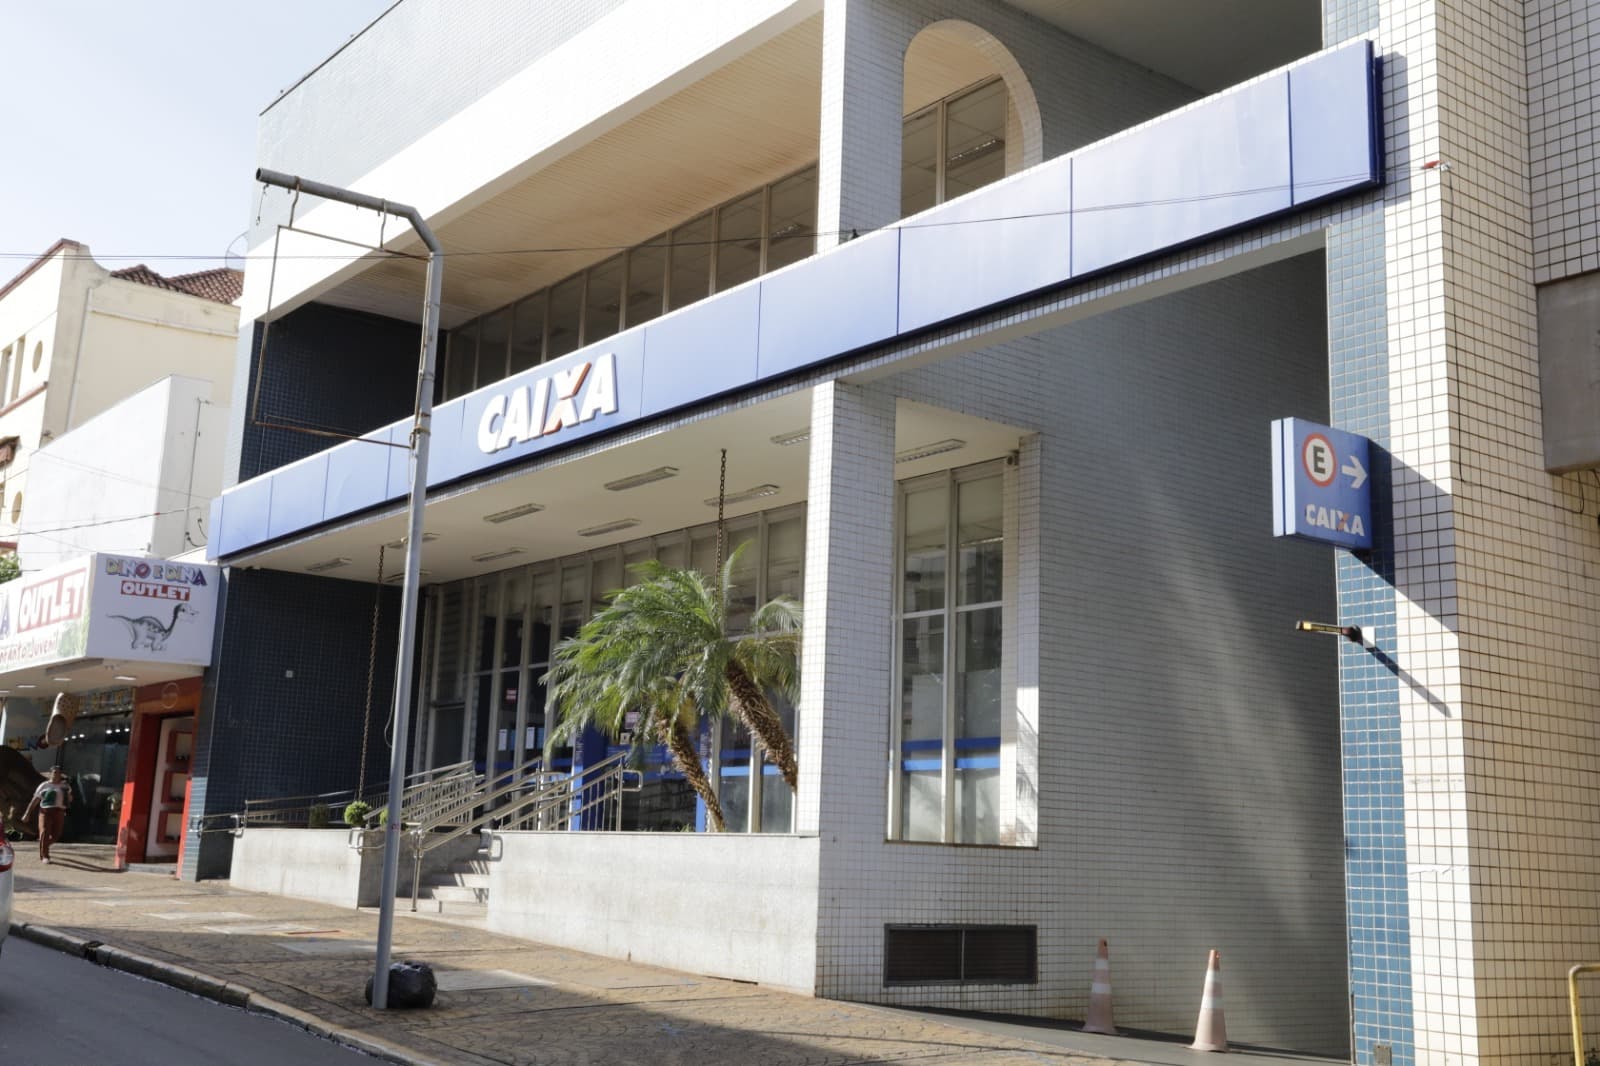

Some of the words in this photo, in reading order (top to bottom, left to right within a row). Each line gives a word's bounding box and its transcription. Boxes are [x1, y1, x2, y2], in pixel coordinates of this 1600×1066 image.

[478, 353, 618, 454] CAIXA
[1313, 446, 1326, 474] E
[1305, 503, 1365, 537] CAIXA
[106, 559, 151, 579] DINO
[165, 564, 208, 586] DINA
[19, 571, 86, 632] OUTLET
[122, 582, 189, 600] OUTLET
